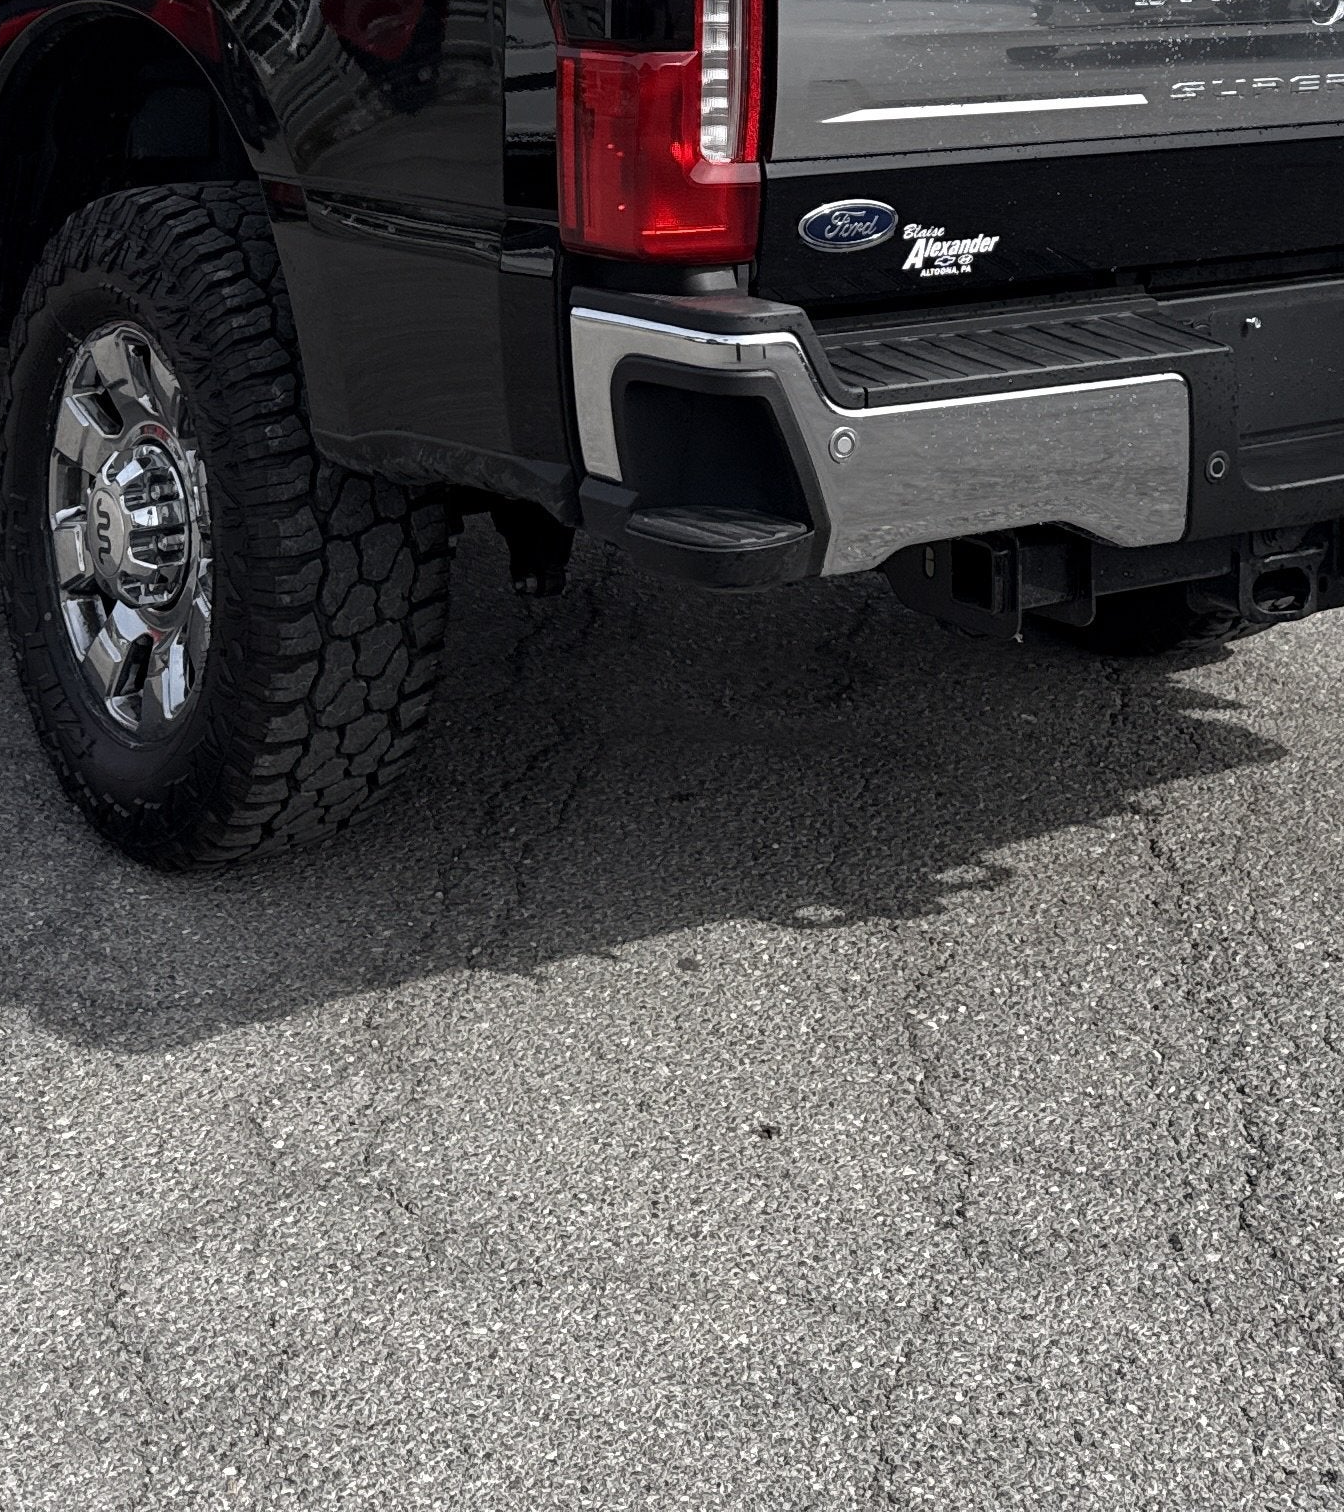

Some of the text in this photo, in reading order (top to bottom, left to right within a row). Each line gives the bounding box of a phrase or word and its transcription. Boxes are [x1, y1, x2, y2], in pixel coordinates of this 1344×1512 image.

[824, 210, 880, 239] Ford
[902, 223, 945, 240] Blaise
[902, 234, 1000, 270] Alexander
